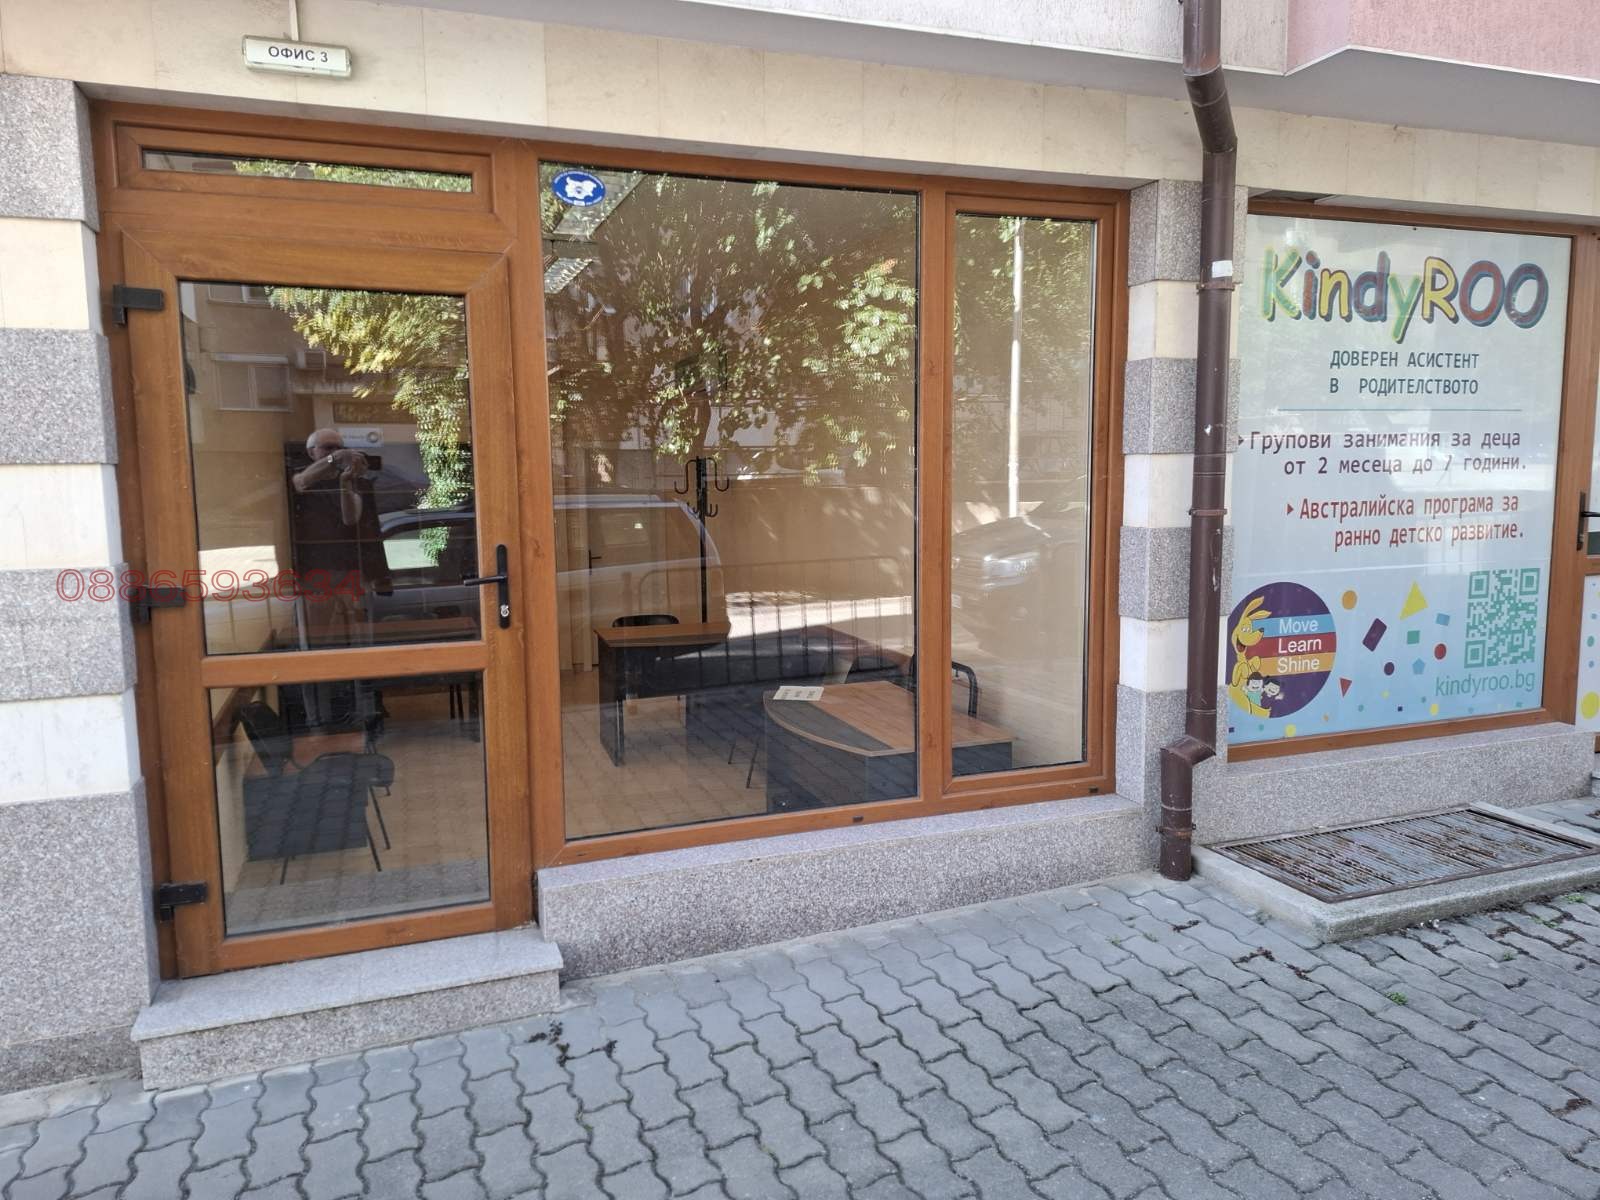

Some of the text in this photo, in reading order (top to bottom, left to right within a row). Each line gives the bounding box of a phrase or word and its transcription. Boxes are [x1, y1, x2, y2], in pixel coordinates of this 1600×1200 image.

[268, 46, 328, 63] ОФИС 3
[1262, 247, 1549, 343] KindyROO
[1330, 350, 1480, 370] ДОВЕРЕН АСИСТЕНТ
[1330, 378, 1479, 397] В РОДИТЕЛСТВОТО
[1250, 431, 1521, 455] Групови занимания за деца
[1284, 459, 1306, 475] от
[1318, 457, 1328, 474] 2
[1338, 457, 1403, 475] месеца
[1412, 457, 1433, 474] до
[1464, 455, 1526, 473] години.
[1300, 494, 1519, 522] Австралийска програма за
[1334, 522, 1524, 552] ранно детско развитие.
[1278, 618, 1319, 634] Move
[1277, 637, 1322, 654] Learn
[1277, 657, 1320, 673] Shine
[1434, 671, 1536, 697] kindyroo.bg
